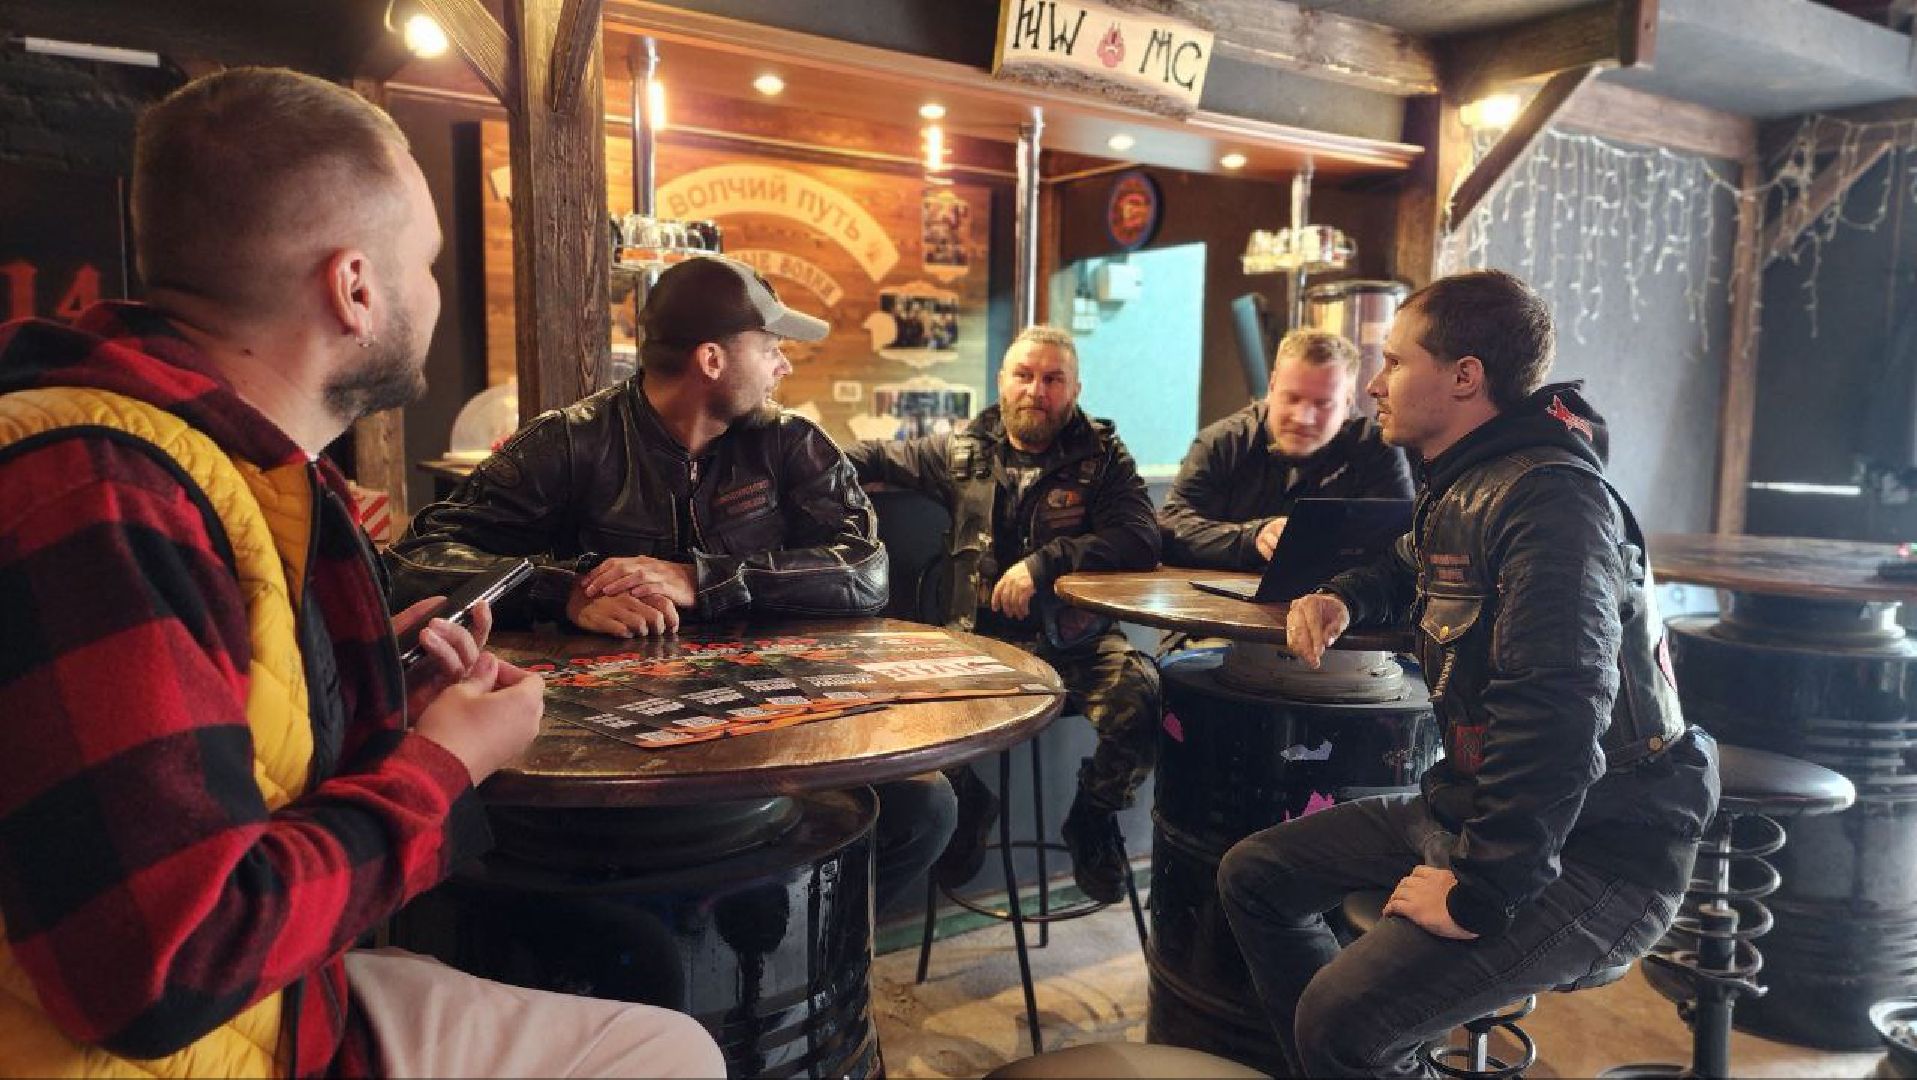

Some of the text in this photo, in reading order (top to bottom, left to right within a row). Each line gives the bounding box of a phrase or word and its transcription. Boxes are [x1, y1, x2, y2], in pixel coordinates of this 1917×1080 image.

[1012, 0, 1202, 91] HW MC
[668, 174, 787, 218] ВОЛЧИЙ
[798, 187, 860, 241] ПУТЬ
